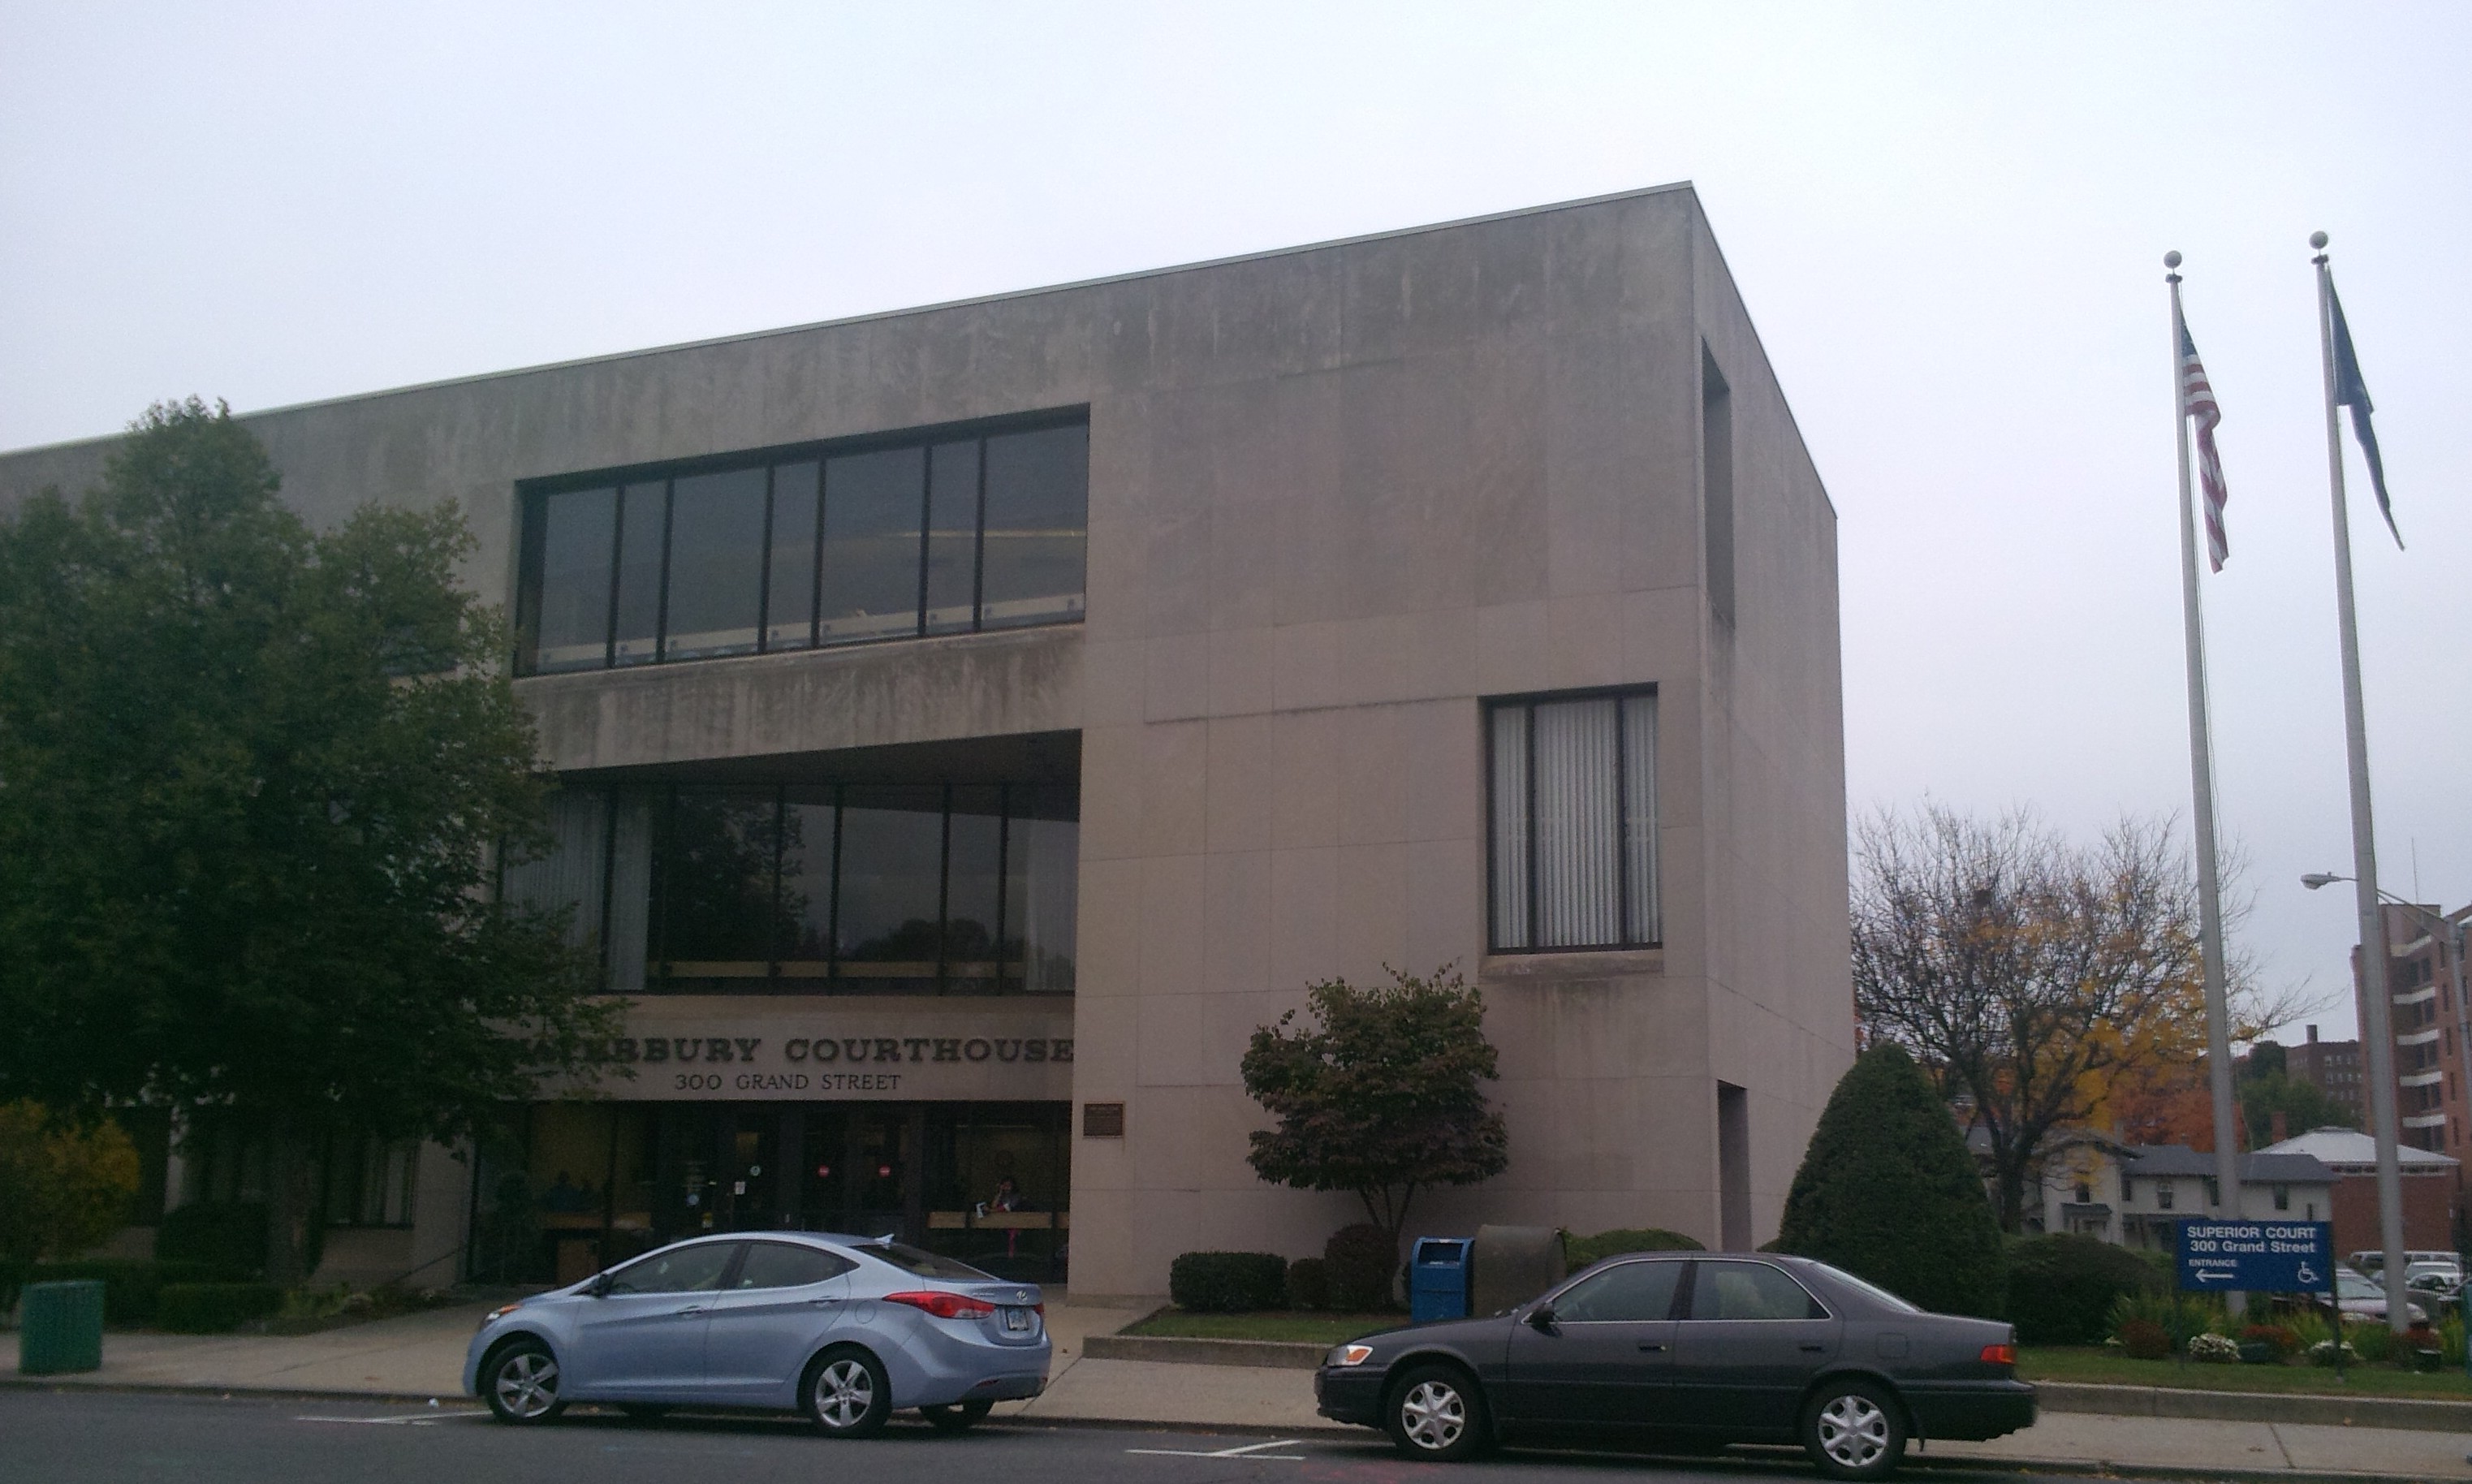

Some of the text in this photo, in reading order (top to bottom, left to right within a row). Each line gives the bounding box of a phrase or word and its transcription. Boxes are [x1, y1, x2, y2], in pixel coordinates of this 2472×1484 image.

[784, 1038, 1073, 1063] COURTHOUSE
[675, 1073, 902, 1091] 300 GRAND STREET
[2187, 1226, 2316, 1239] SUPERIOR COURT
[2190, 1240, 2316, 1253] 300 Grand Street
[2188, 1258, 2237, 1267] ENTRANCE
